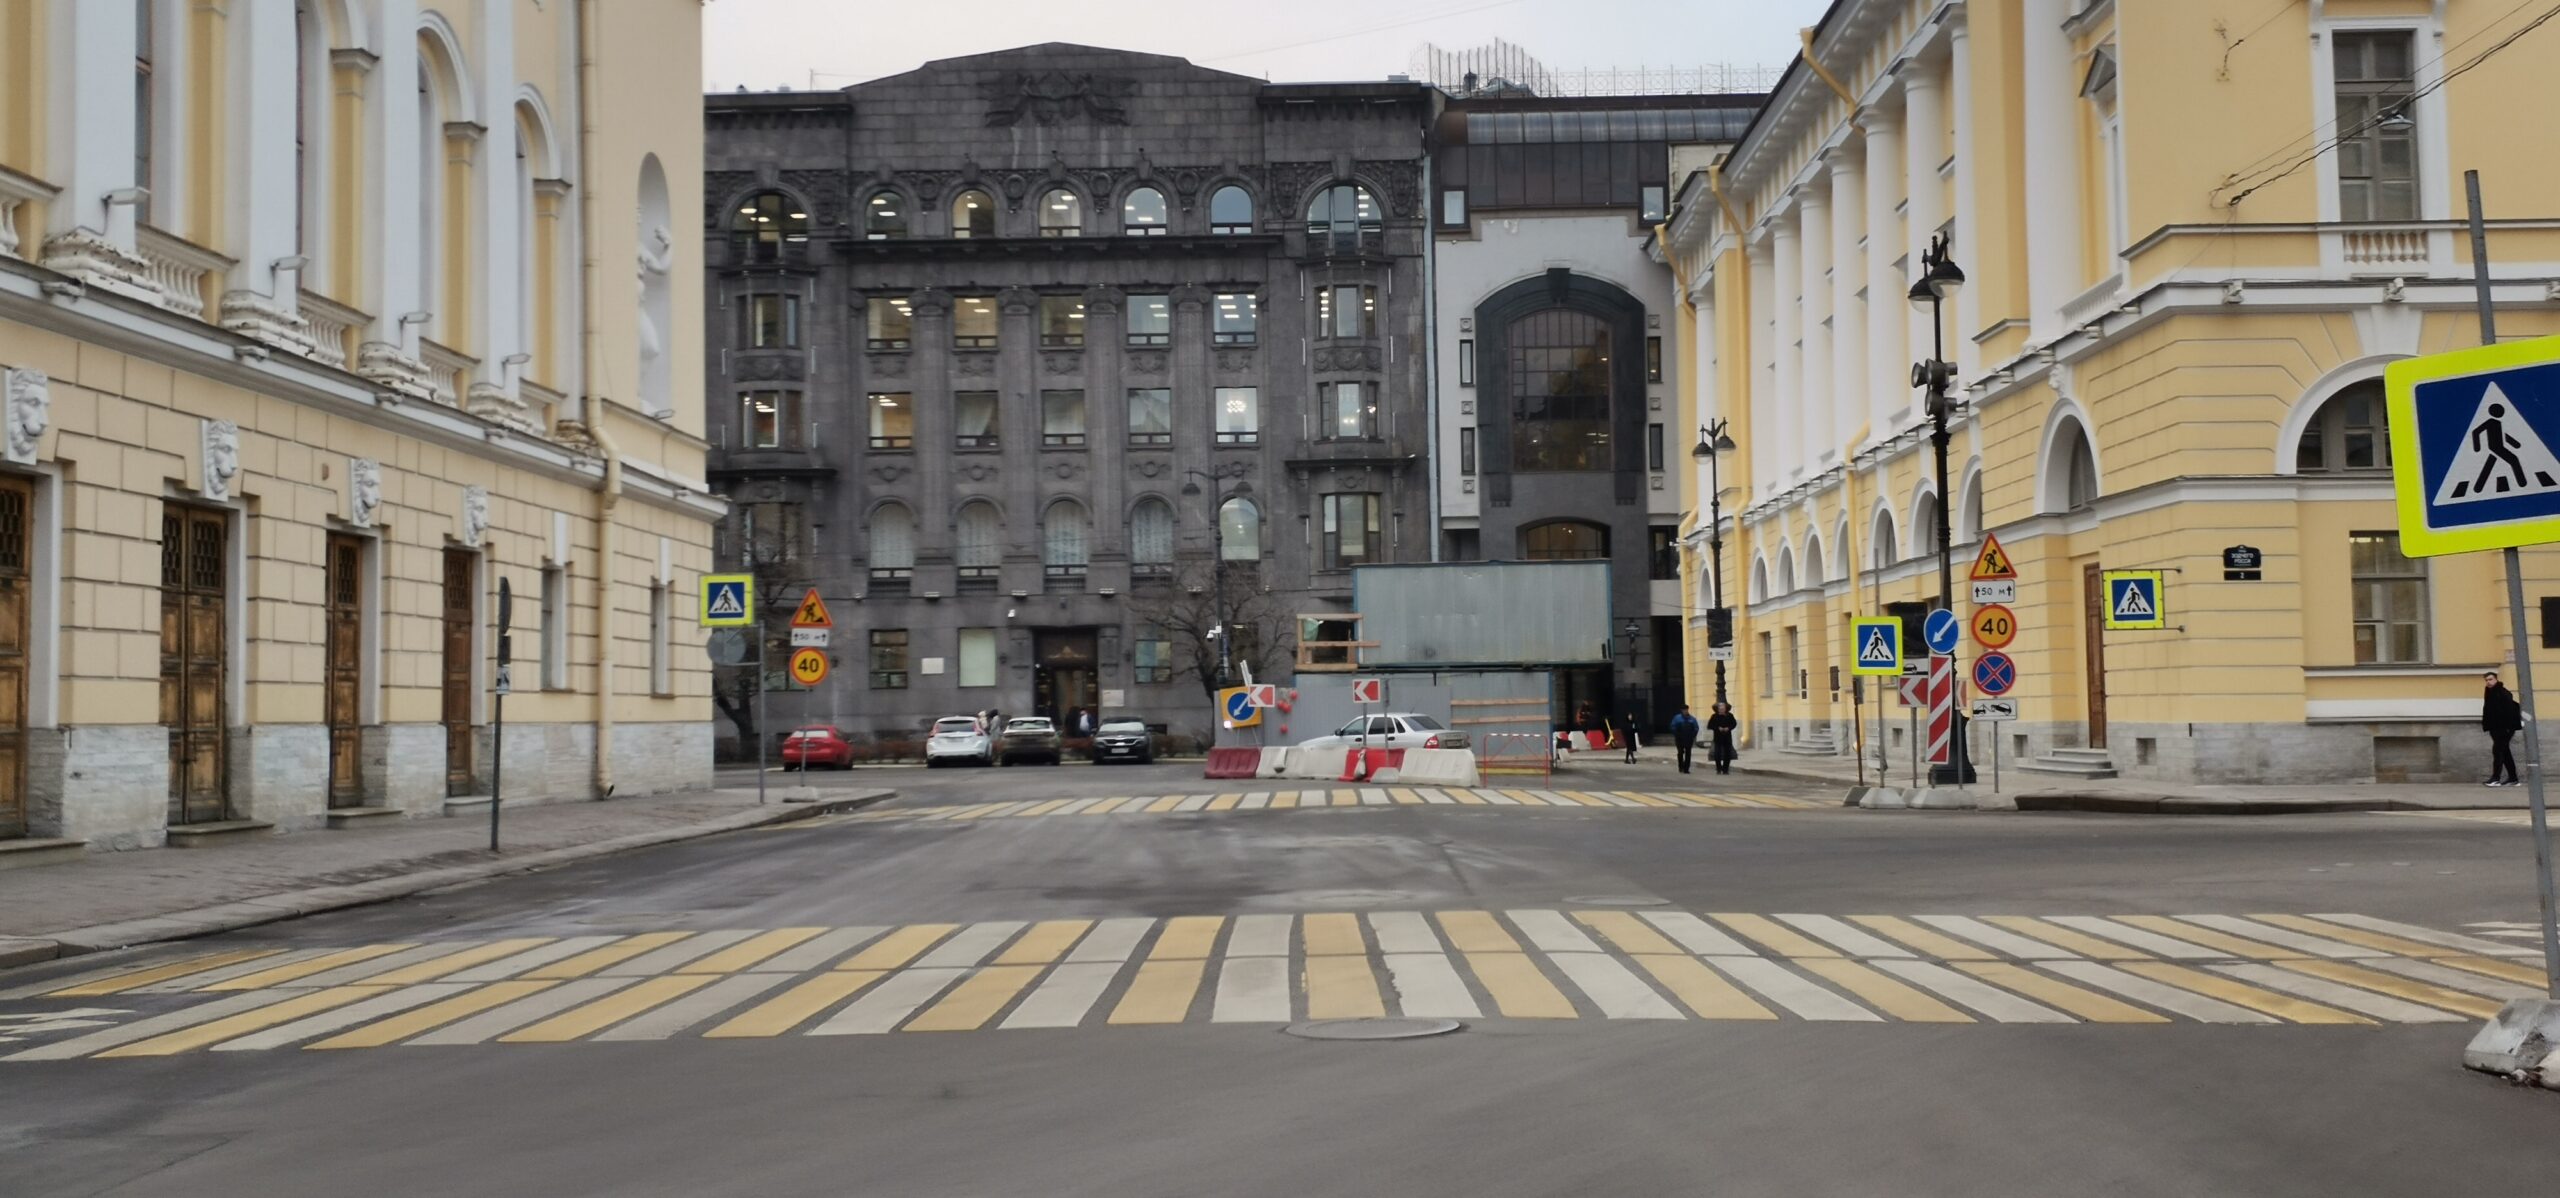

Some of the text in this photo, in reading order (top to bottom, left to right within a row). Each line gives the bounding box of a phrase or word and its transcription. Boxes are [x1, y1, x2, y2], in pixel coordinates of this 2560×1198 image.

[1981, 587, 1993, 596] 50
[1980, 618, 2008, 635] 40
[797, 658, 820, 672] 40
